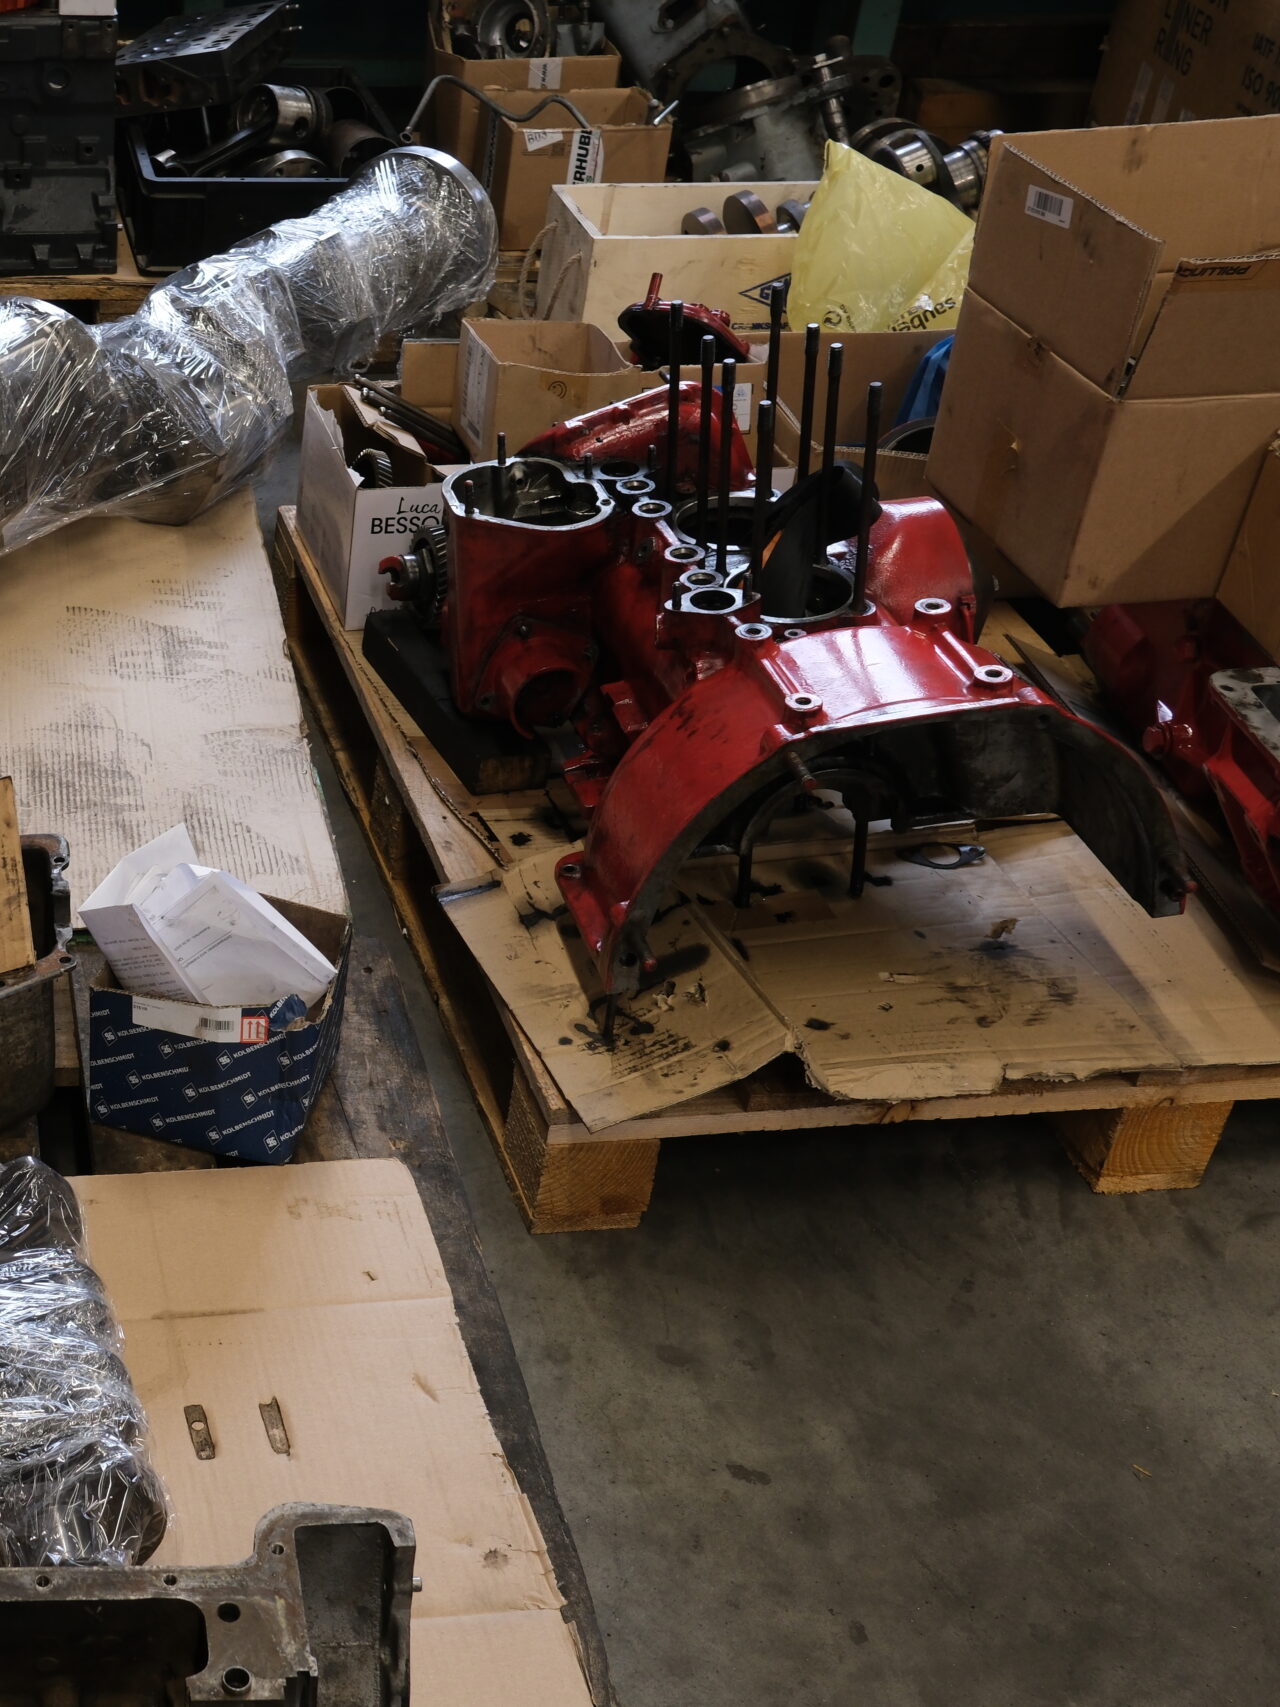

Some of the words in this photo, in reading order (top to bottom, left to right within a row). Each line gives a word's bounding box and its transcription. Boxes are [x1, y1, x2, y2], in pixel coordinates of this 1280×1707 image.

[397, 496, 441, 515] Luca
[198, 1071, 252, 1094] KOLBENSCHMIDT
[257, 1074, 311, 1097] KOLBENSCHMIDT
[110, 1096, 160, 1111] KOLBENSCHMIDT
[165, 1108, 216, 1124] KOLBENSCHMIDT
[222, 1109, 275, 1136] KOLBENSCHMIDT
